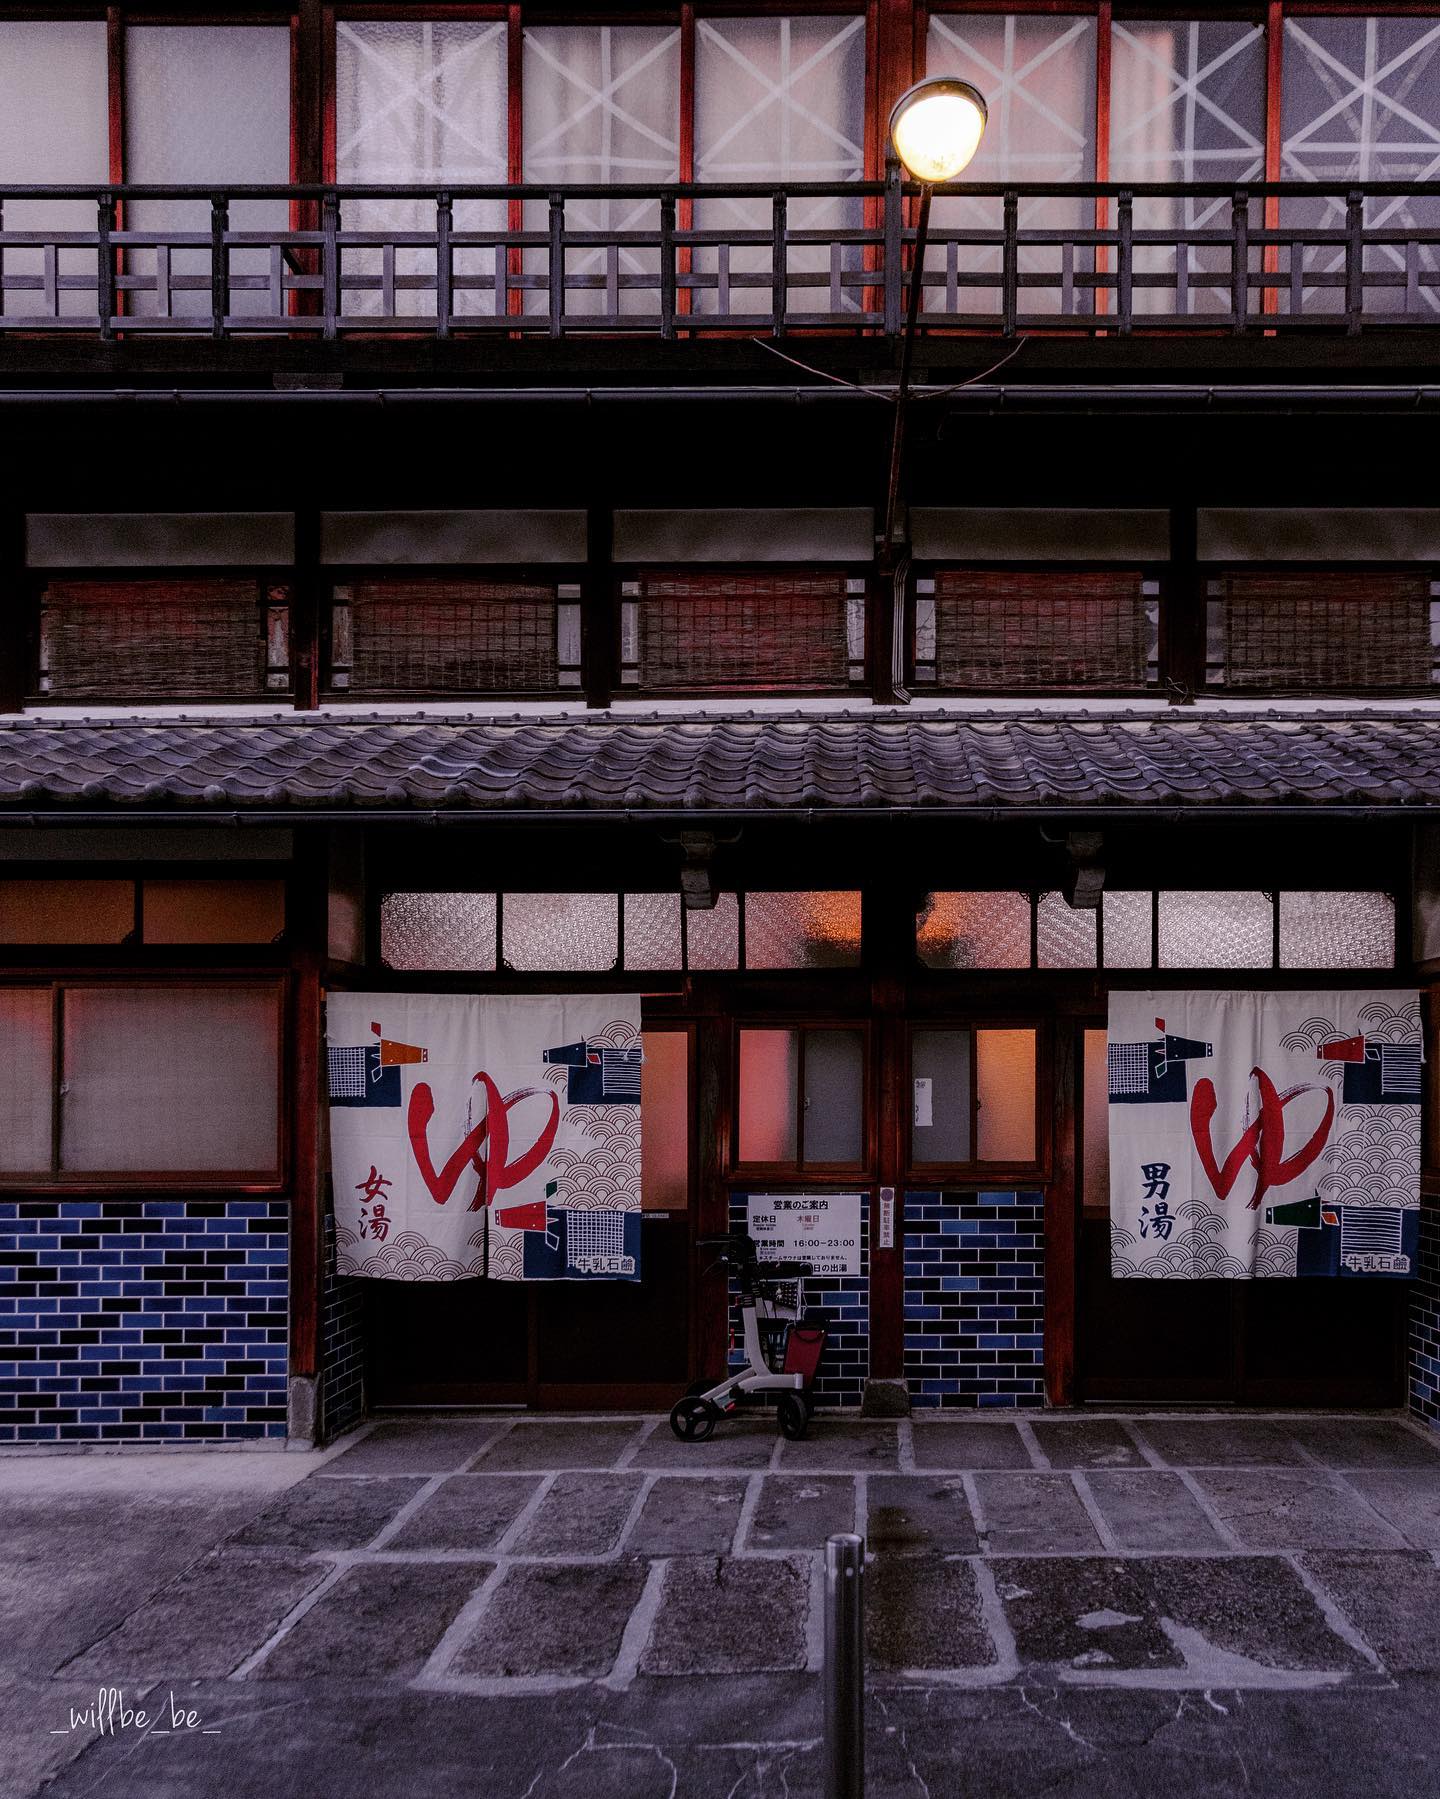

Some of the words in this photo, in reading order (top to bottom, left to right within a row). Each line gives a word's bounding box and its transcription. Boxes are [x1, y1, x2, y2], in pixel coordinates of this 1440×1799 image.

[407, 1071, 560, 1212] ゆ
[1190, 1066, 1335, 1210] ゆ
[355, 1166, 392, 1242] 女湯
[752, 1215, 776, 1223] 定休日
[773, 1200, 828, 1210] 営業のご案内
[1138, 1163, 1176, 1241] 男湯
[754, 1239, 785, 1248] 営業時間
[813, 1264, 848, 1273] 日の出湯
